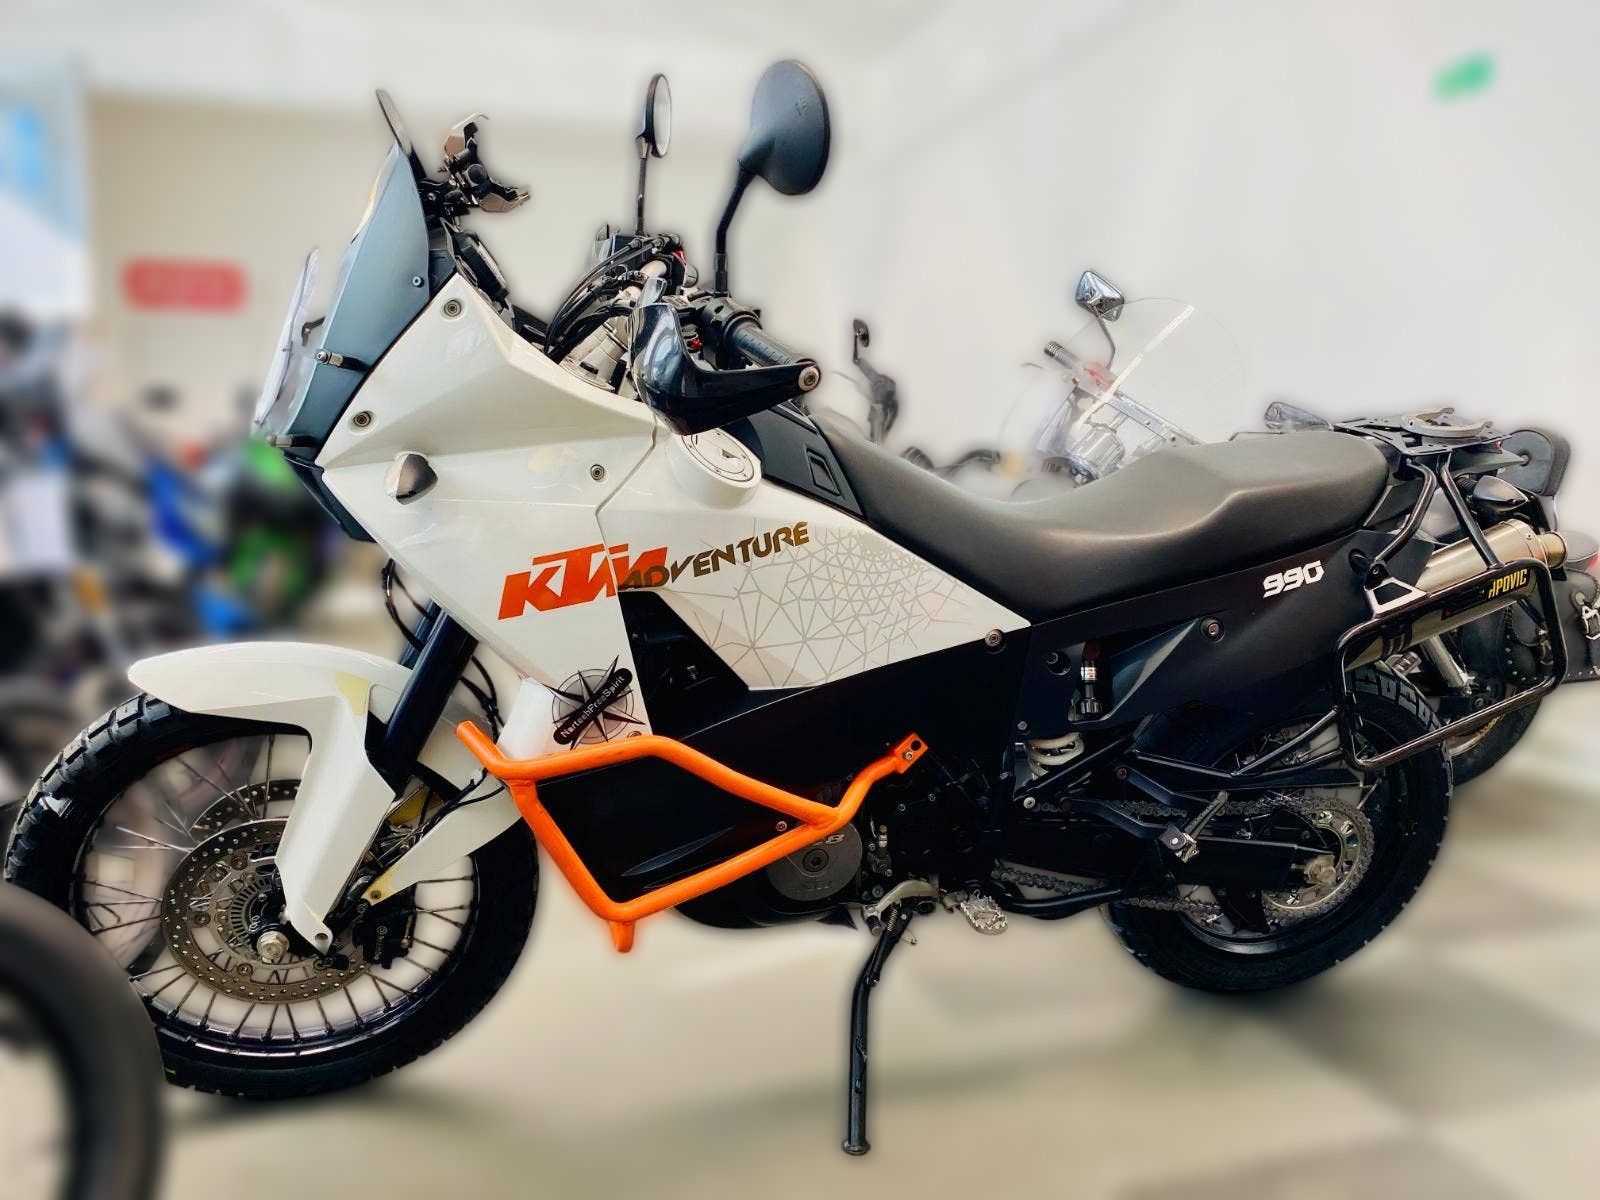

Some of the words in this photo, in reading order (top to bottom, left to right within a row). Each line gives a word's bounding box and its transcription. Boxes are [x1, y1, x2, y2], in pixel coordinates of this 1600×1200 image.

[498, 543, 668, 620] KTM
[618, 521, 810, 590] ADVENTURE
[1263, 560, 1325, 598] 990
[1488, 568, 1528, 599] APOVIC
